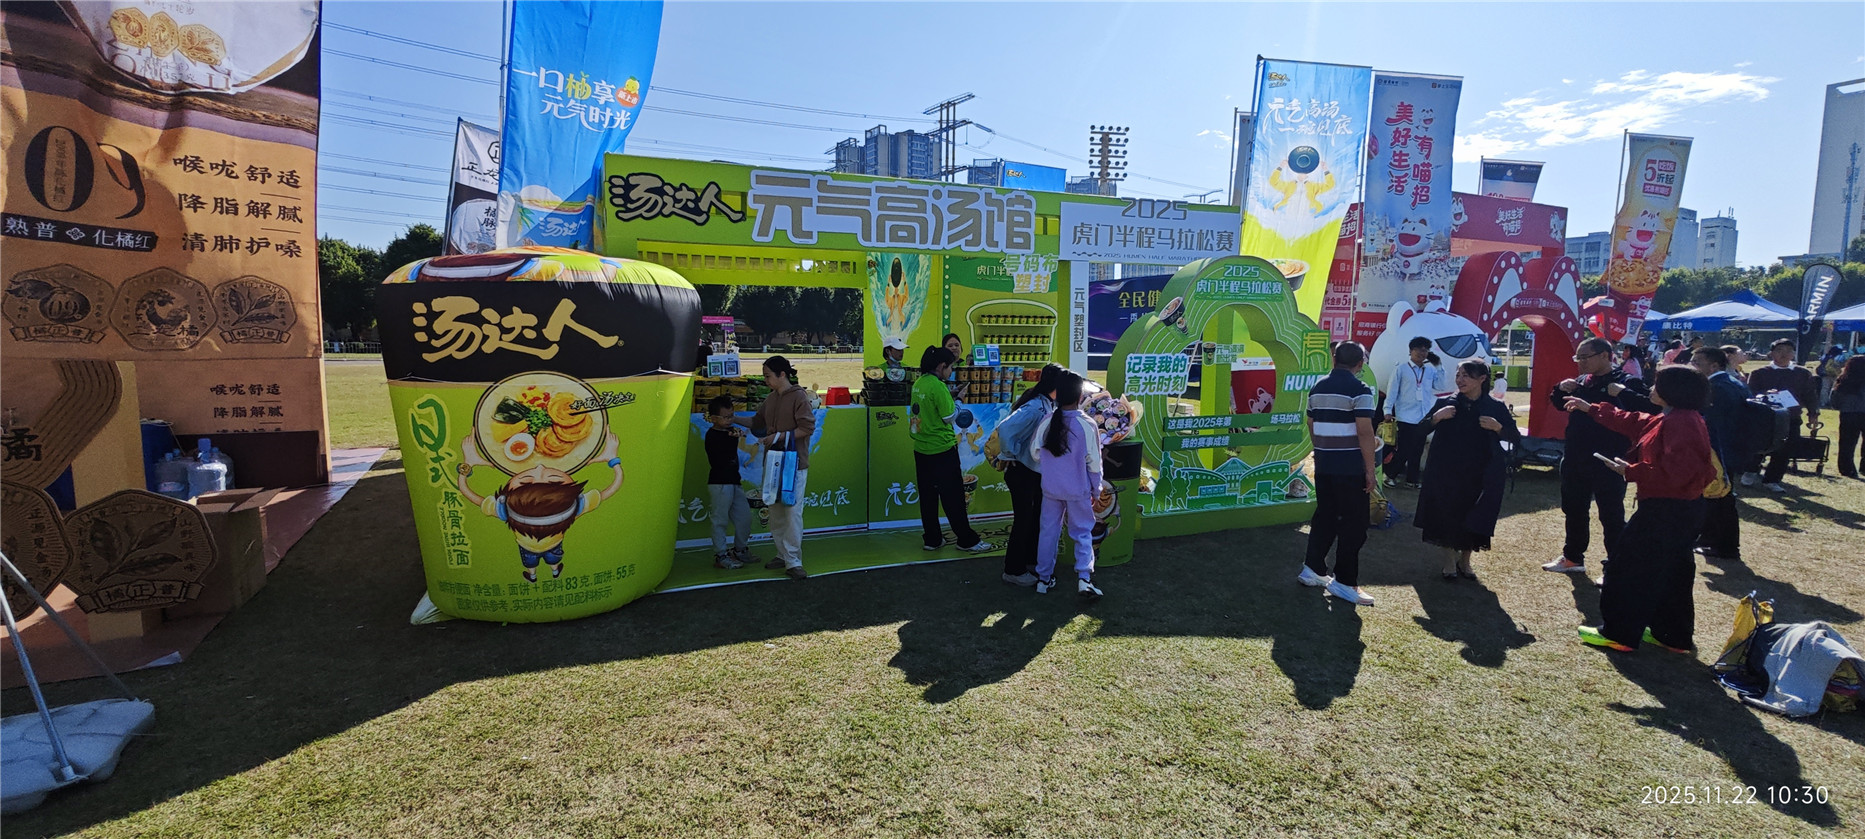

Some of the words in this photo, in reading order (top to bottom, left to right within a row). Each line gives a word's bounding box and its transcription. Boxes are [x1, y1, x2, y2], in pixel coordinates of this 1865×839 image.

[539, 93, 632, 132] 元气时光
[1385, 101, 1415, 195] 美好生活
[24, 125, 147, 221] 09
[172, 154, 303, 190] 喉咙舒适
[1411, 133, 1434, 209] 有喵招
[1644, 159, 1657, 182] 5
[1656, 173, 1675, 185] 折起
[178, 193, 303, 225] 降脂解腻
[609, 172, 746, 226] 汤达人
[748, 168, 1037, 254] 元气高汤馆
[1121, 197, 1188, 221] 2025
[4, 216, 57, 239] 熟普
[92, 229, 153, 250] 化橘红
[181, 232, 303, 258] 清肺护嗓
[1072, 222, 1234, 252] 虎门半程马拉松赛
[1004, 254, 1058, 272] 号码布
[1224, 265, 1259, 278] 2025
[1015, 273, 1051, 293] 塑封
[1196, 280, 1283, 295] 虎门半程马拉松赛
[412, 295, 619, 364] 汤达人
[1074, 287, 1085, 352] 元气塑封区
[1127, 355, 1188, 375] 记录我的
[210, 383, 282, 396] 喉咙舒适
[1126, 375, 1188, 394] 高光时刻
[213, 405, 284, 419] 降脂解腻
[1167, 416, 1233, 431] 这是我2025年第
[1270, 413, 1301, 425] 场马拉松
[443, 491, 471, 566] 豚骨拉面
